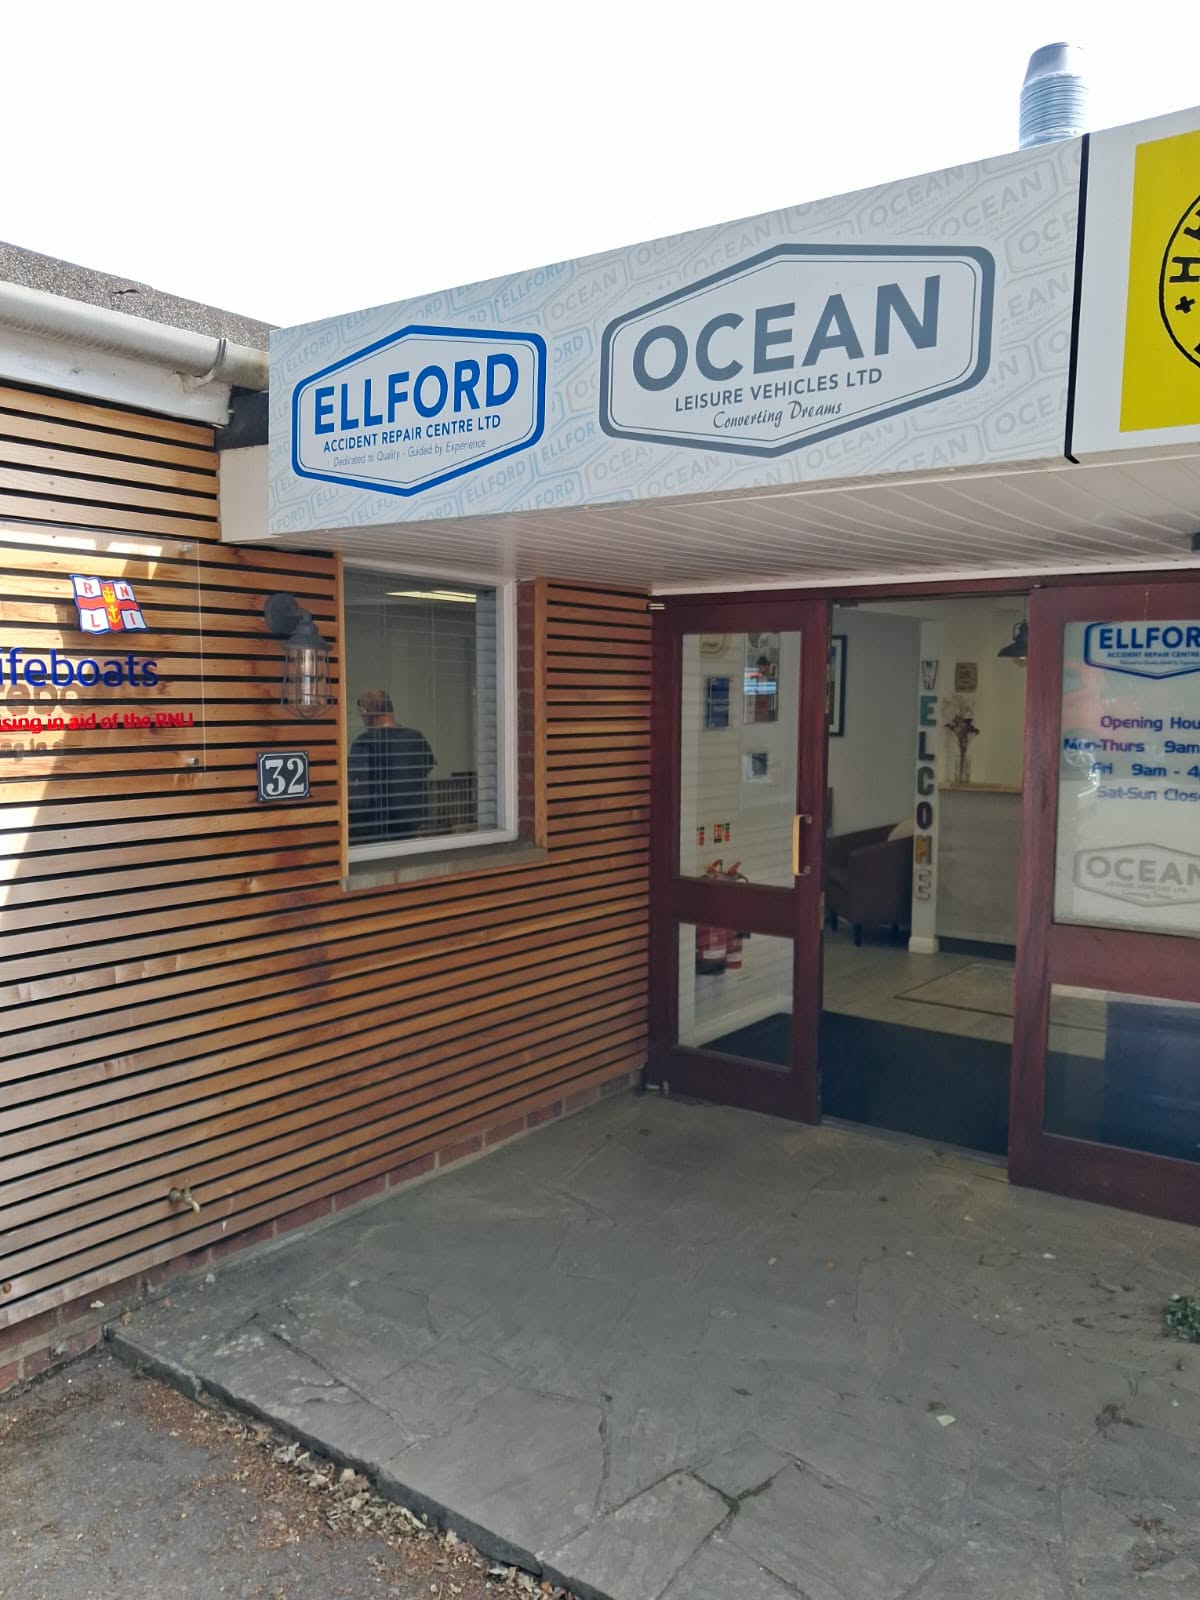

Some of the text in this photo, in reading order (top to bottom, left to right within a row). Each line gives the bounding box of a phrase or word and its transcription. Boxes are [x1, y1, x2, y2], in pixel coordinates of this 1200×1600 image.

[551, 268, 617, 320] OCEAN
[633, 275, 940, 391] OCEAN
[314, 353, 519, 435] ELLFORD
[675, 368, 882, 412] LEISURE VEHICLES LTD
[713, 400, 842, 429] Converting Dreams
[323, 414, 501, 453] ACCIDENT REPAIR CENTRE LTD
[333, 452, 366, 467] Dedicated
[377, 448, 400, 462] Quality
[407, 445, 433, 458] Guided
[434, 443, 442, 456] by
[446, 440, 486, 454] Experience
[466, 461, 526, 503] ELLFORD
[1099, 626, 1200, 650] ELLFOR
[0, 712, 194, 734] sing in aid of the RNLI
[1101, 715, 1163, 732] Opening
[1164, 740, 1200, 754] 9am
[264, 757, 305, 797] 32
[915, 659, 940, 900] WELCOME
[1091, 762, 1113, 775] Fri
[1131, 763, 1167, 776] 9am
[1097, 786, 1200, 802] Sat-Sun Clos
